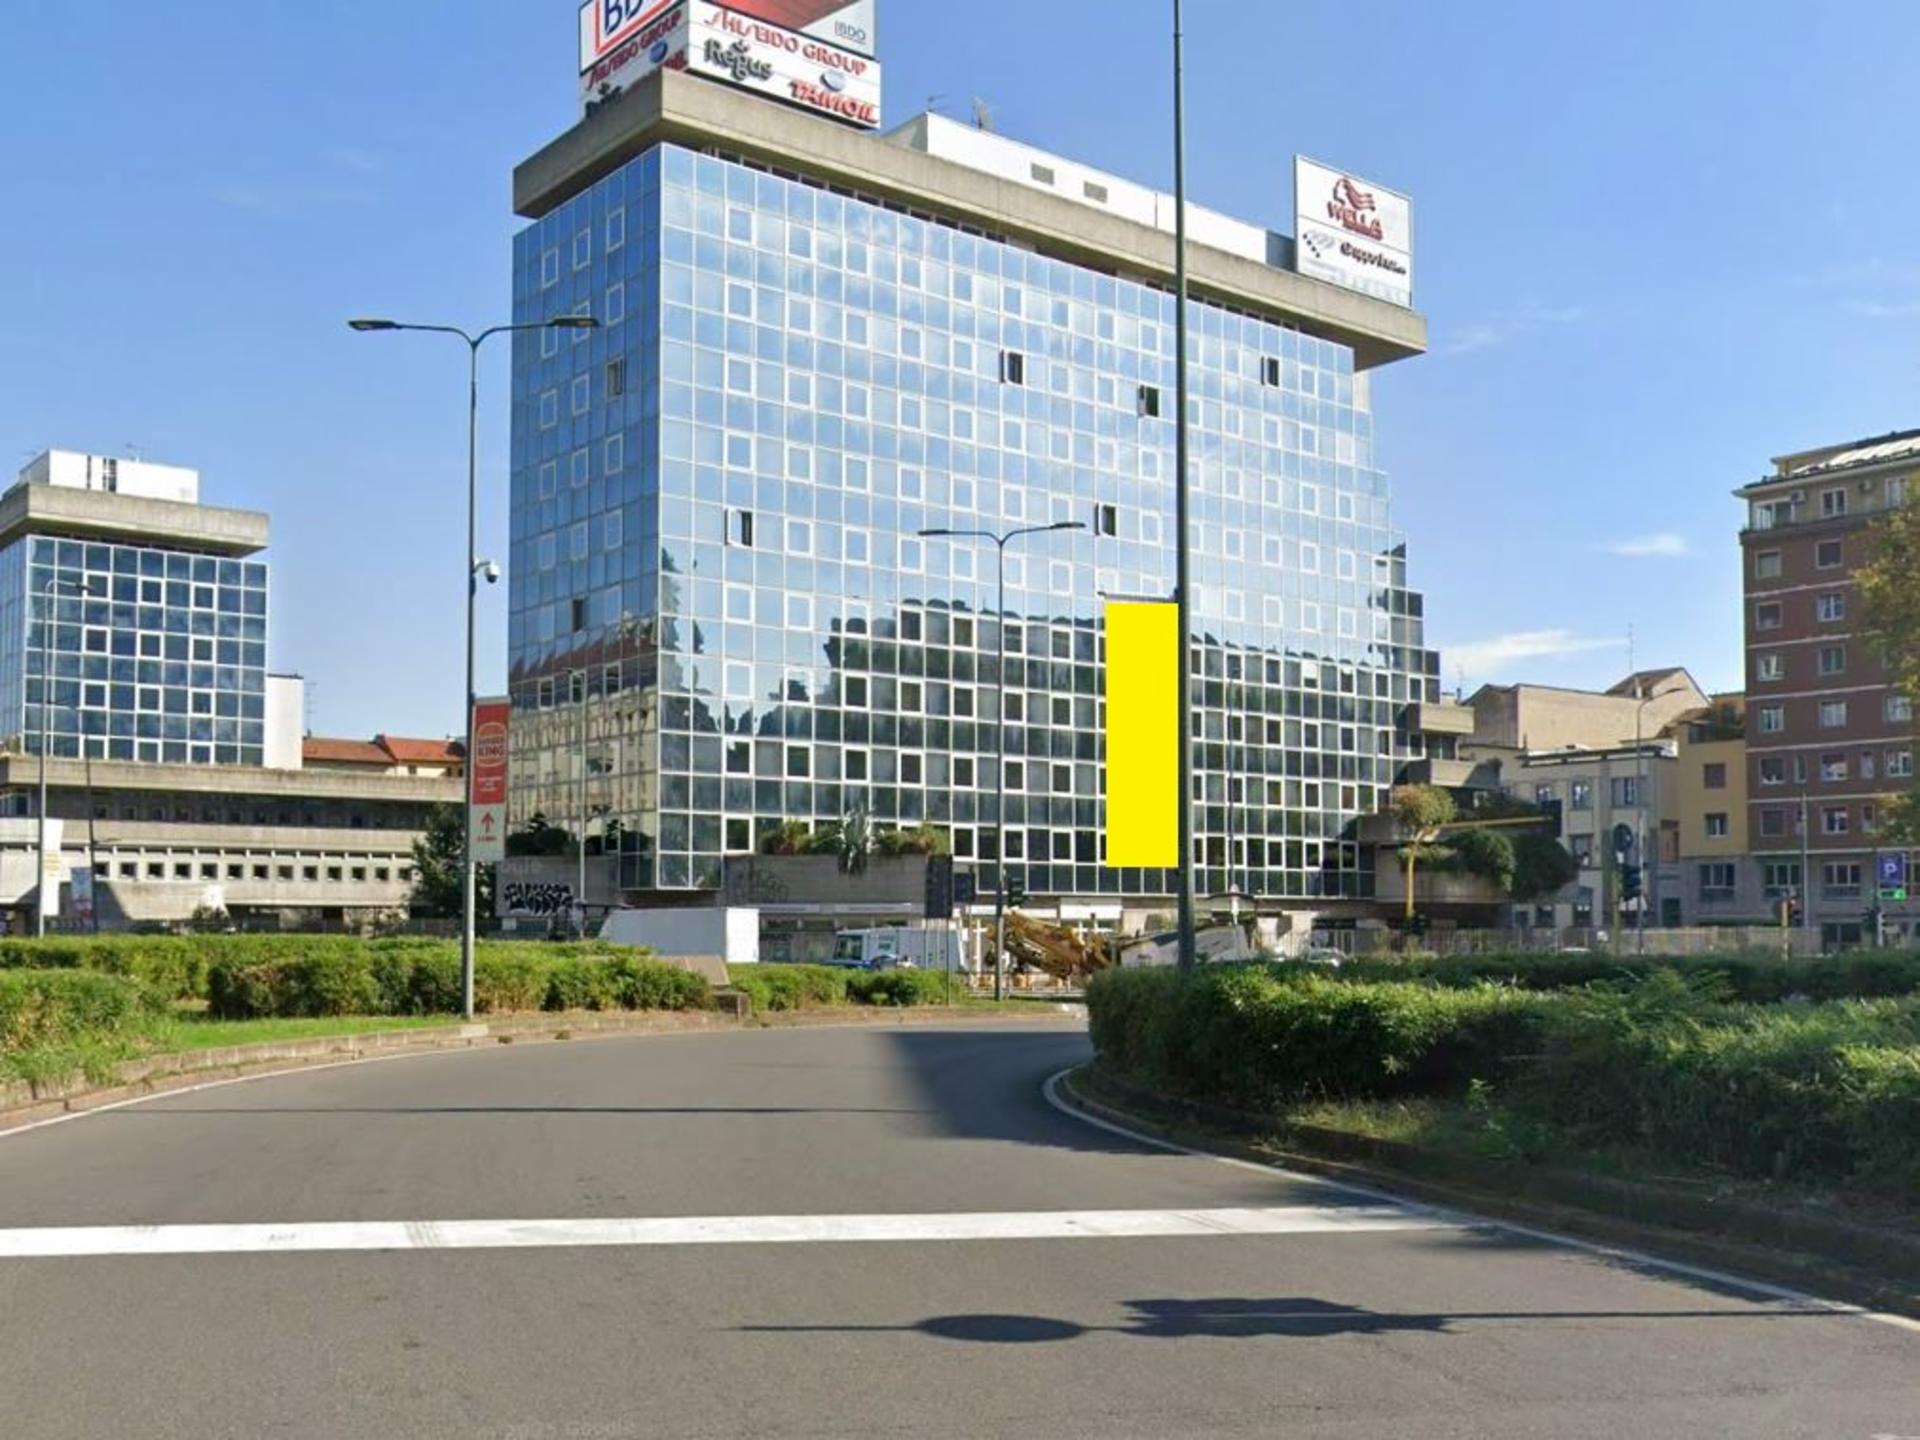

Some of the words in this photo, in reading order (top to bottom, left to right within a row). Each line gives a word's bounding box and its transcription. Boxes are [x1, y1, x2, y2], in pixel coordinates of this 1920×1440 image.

[703, 39, 774, 81] Regus
[802, 43, 868, 76] GROUP
[1884, 862, 1898, 878] P
